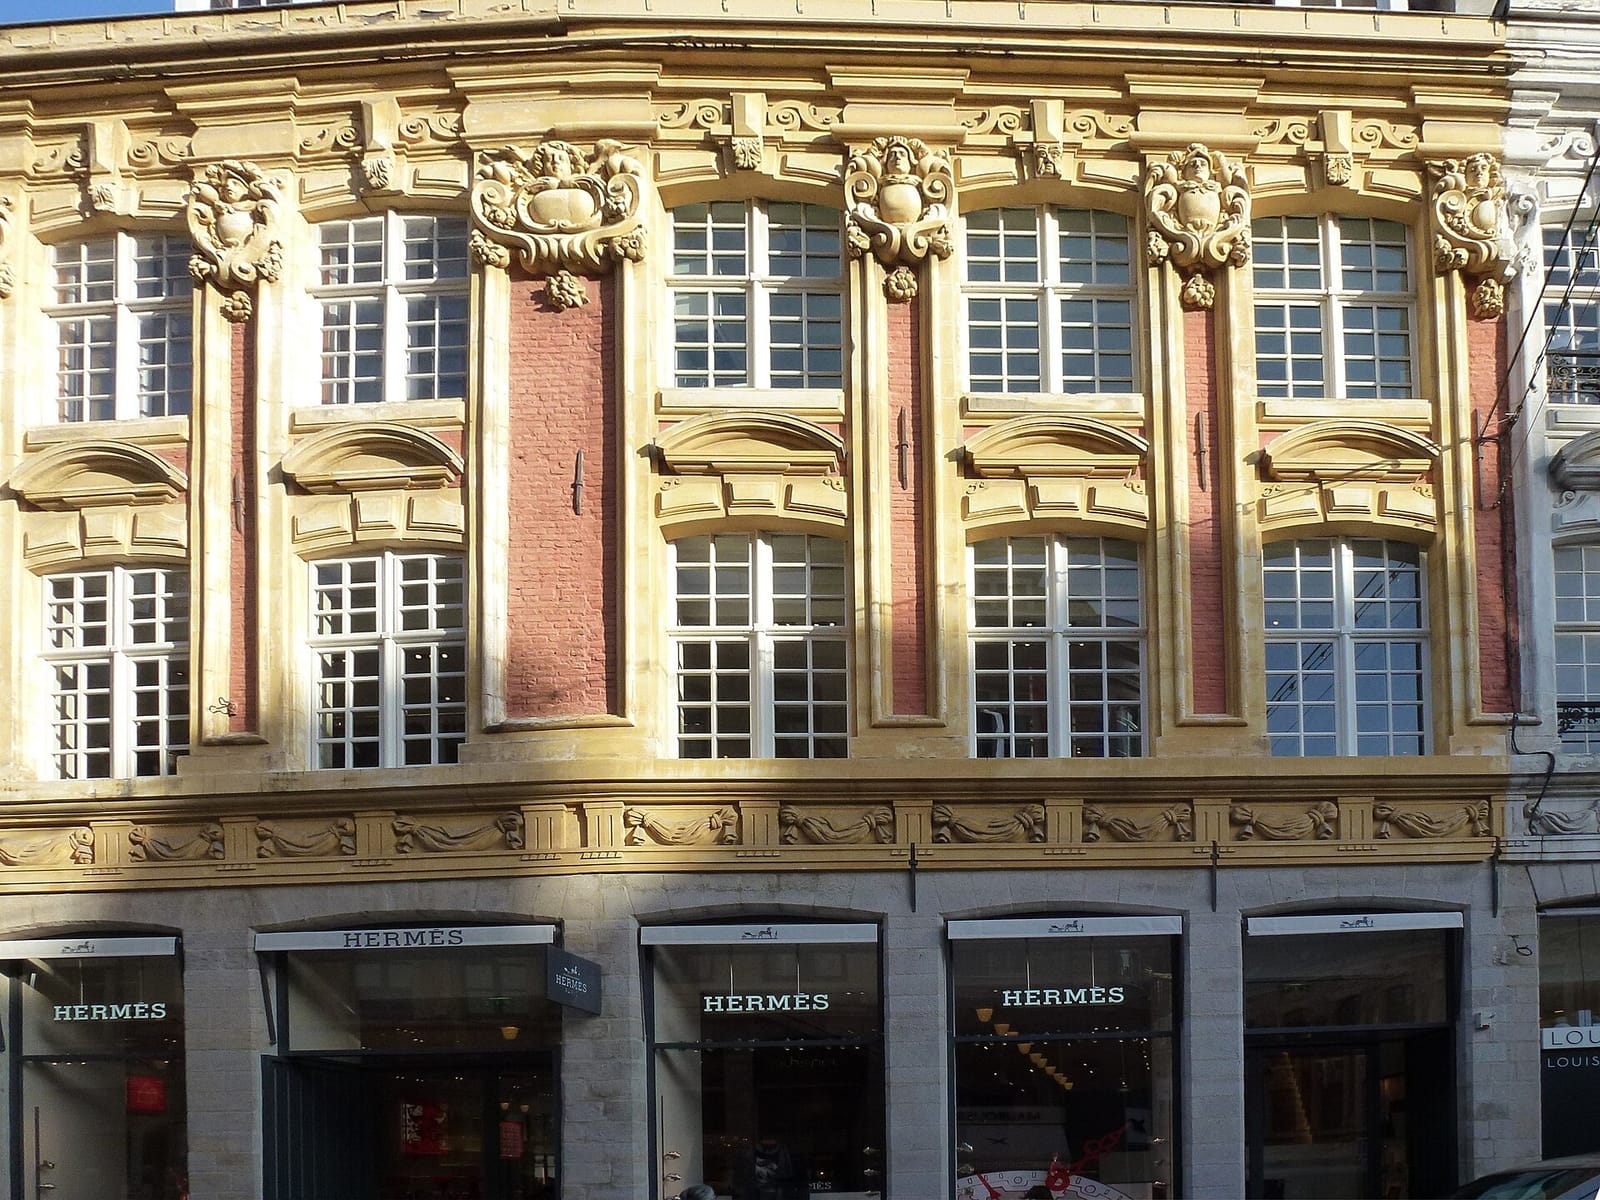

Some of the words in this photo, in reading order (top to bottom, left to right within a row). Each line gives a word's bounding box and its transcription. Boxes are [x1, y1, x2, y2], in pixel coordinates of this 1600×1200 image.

[343, 929, 464, 948] HERMÈS
[703, 993, 829, 1012] HERMÈS
[1002, 986, 1125, 1006] HERMÈS
[53, 1002, 167, 1021] HERMÈS
[1547, 1056, 1600, 1068] LOUIS
